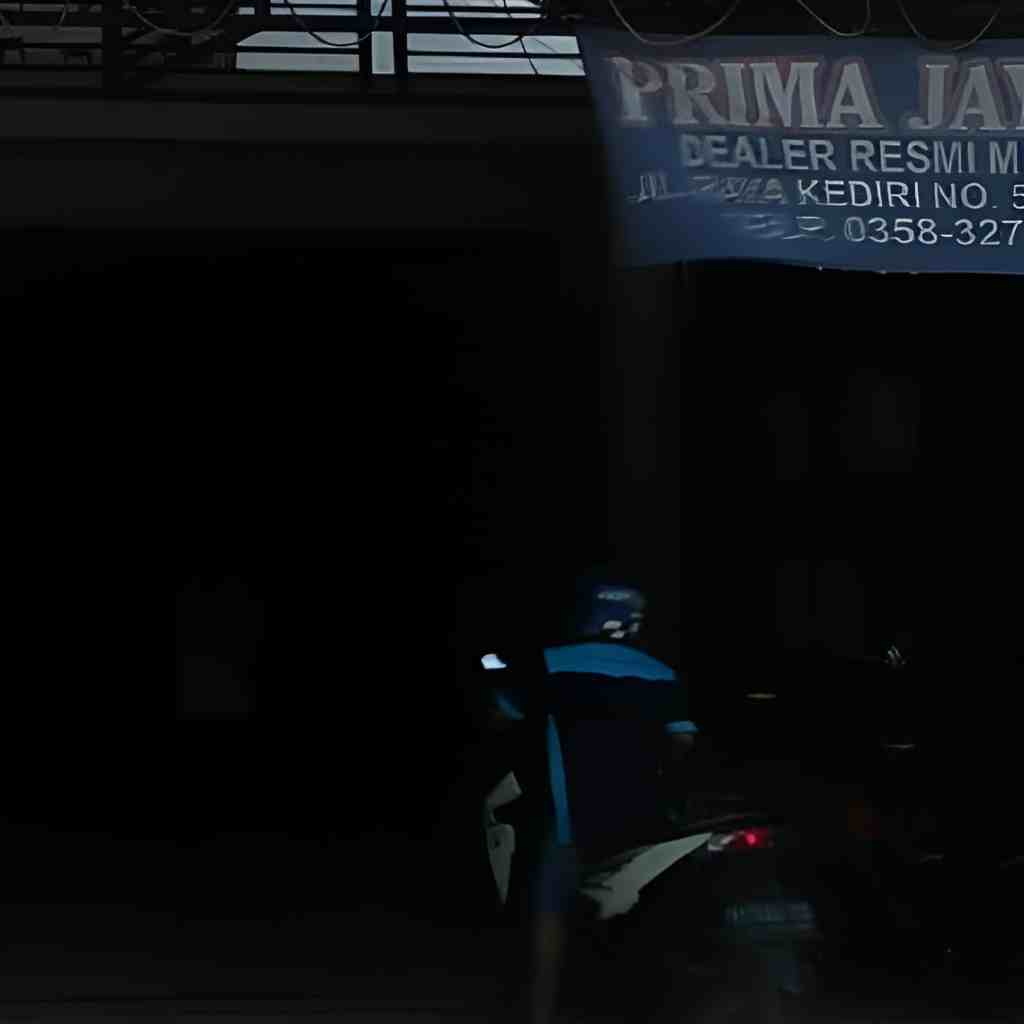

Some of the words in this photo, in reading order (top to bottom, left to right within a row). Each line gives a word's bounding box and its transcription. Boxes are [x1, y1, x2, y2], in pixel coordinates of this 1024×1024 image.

[607, 57, 884, 129] PRIMA
[680, 133, 837, 171] DEALER
[850, 139, 977, 174] RESMI
[797, 180, 921, 209] KEDIRI
[933, 182, 998, 209] NO.
